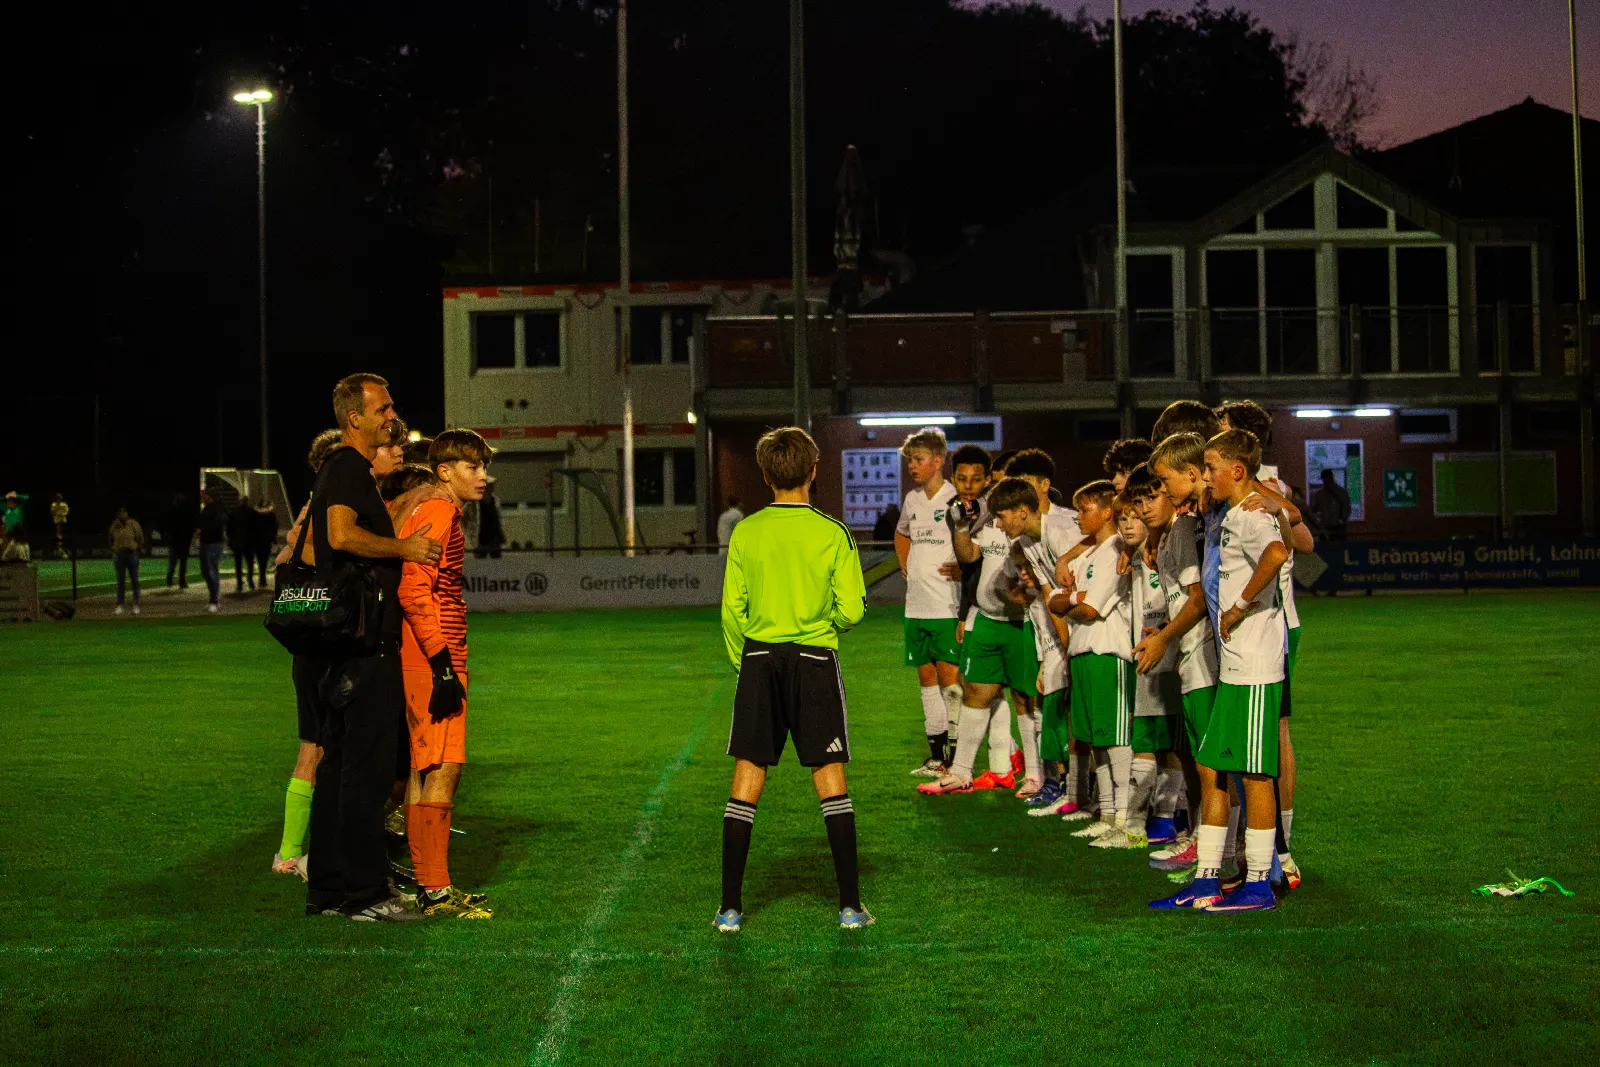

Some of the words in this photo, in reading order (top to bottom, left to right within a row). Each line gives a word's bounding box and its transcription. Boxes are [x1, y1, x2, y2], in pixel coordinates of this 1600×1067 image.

[1343, 548, 1359, 566] L.
[1473, 543, 1541, 564] GmbH,
[460, 576, 520, 592] Allianz
[278, 587, 329, 601] ABSOLUTE
